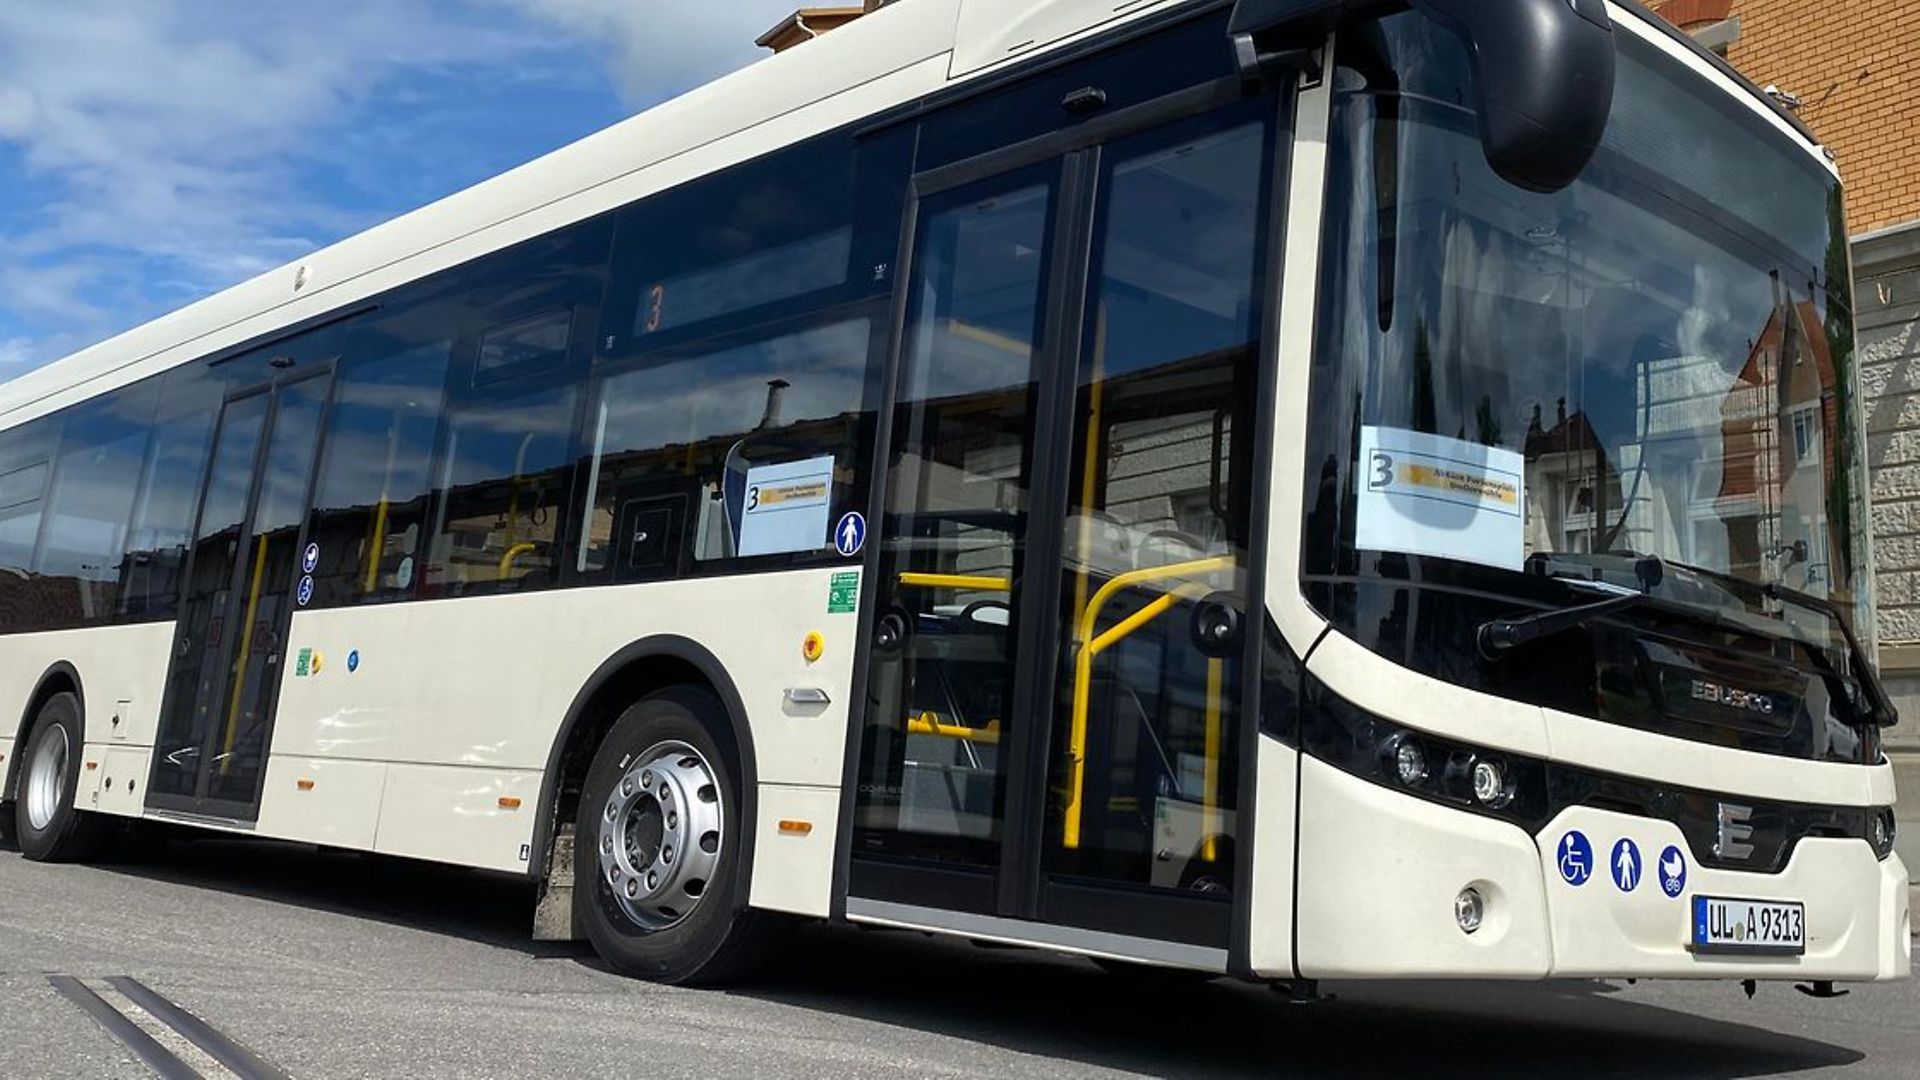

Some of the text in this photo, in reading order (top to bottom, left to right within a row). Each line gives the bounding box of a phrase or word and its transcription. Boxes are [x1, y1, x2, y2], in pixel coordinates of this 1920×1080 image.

[646, 284, 663, 332] 3
[1371, 453, 1393, 487] 3
[747, 486, 758, 511] 3
[1692, 680, 1772, 713] EBUSCO
[1710, 904, 1801, 941] UL A 9313
